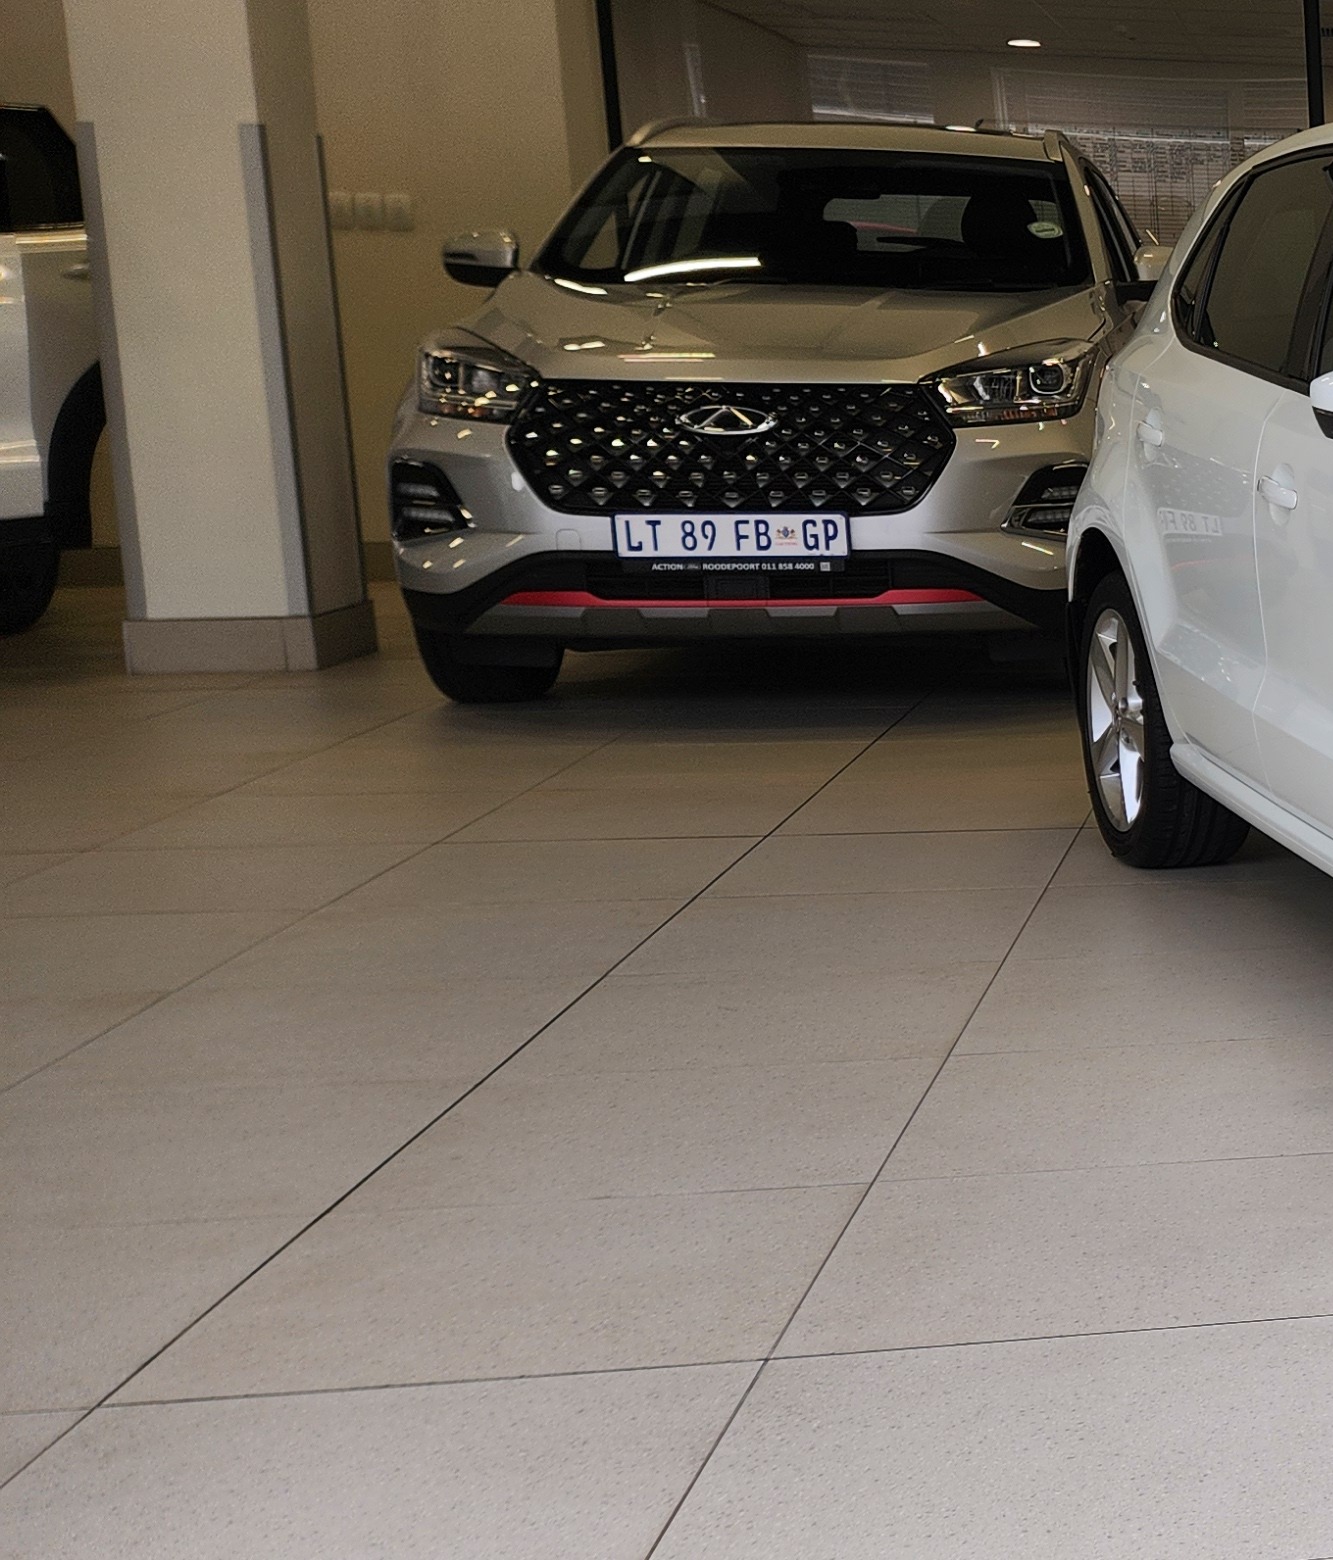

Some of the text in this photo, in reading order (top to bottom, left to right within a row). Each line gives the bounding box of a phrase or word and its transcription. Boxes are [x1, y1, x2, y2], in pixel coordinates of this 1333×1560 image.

[624, 518, 839, 551] LT 89 FB GP
[651, 563, 684, 571] ACTION
[702, 562, 760, 571] ROODEPOORT
[761, 562, 777, 571] 011
[794, 562, 815, 571] 4000
